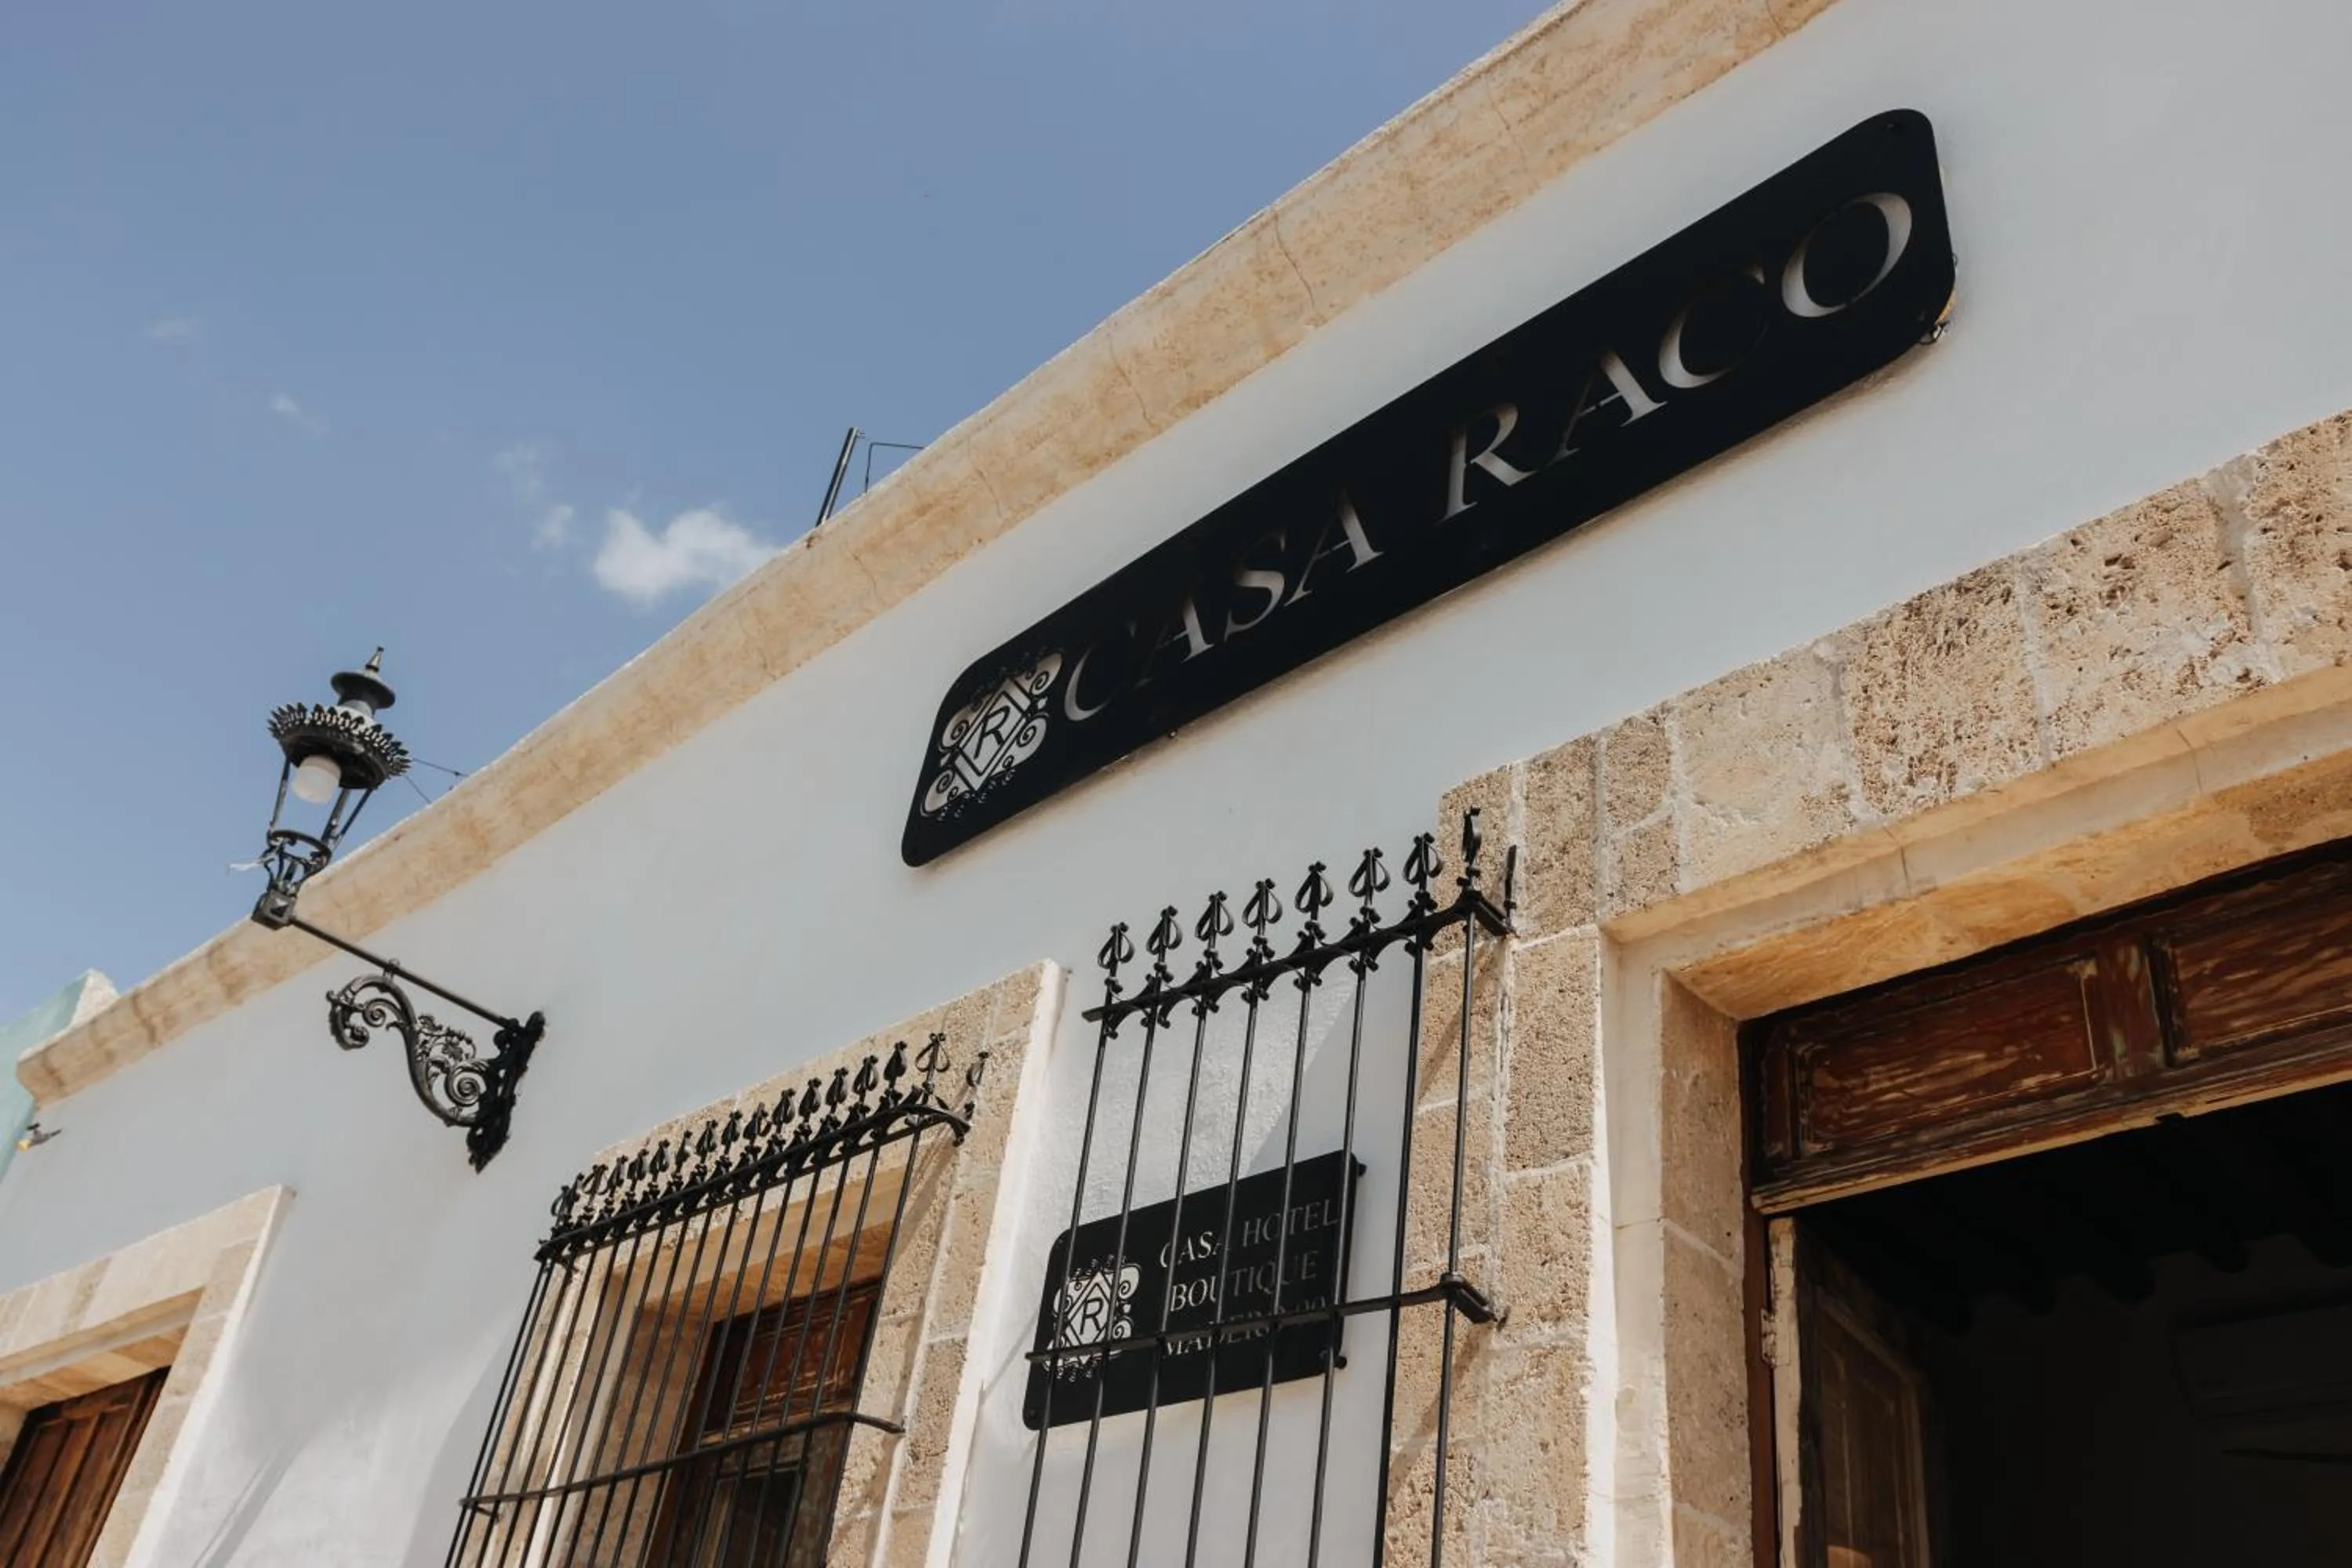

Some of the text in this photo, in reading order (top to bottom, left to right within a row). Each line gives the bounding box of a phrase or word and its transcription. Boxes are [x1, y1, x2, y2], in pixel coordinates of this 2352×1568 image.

[1063, 191, 1914, 723] CASA RACO
[1242, 1198, 1340, 1247] HOTEL
